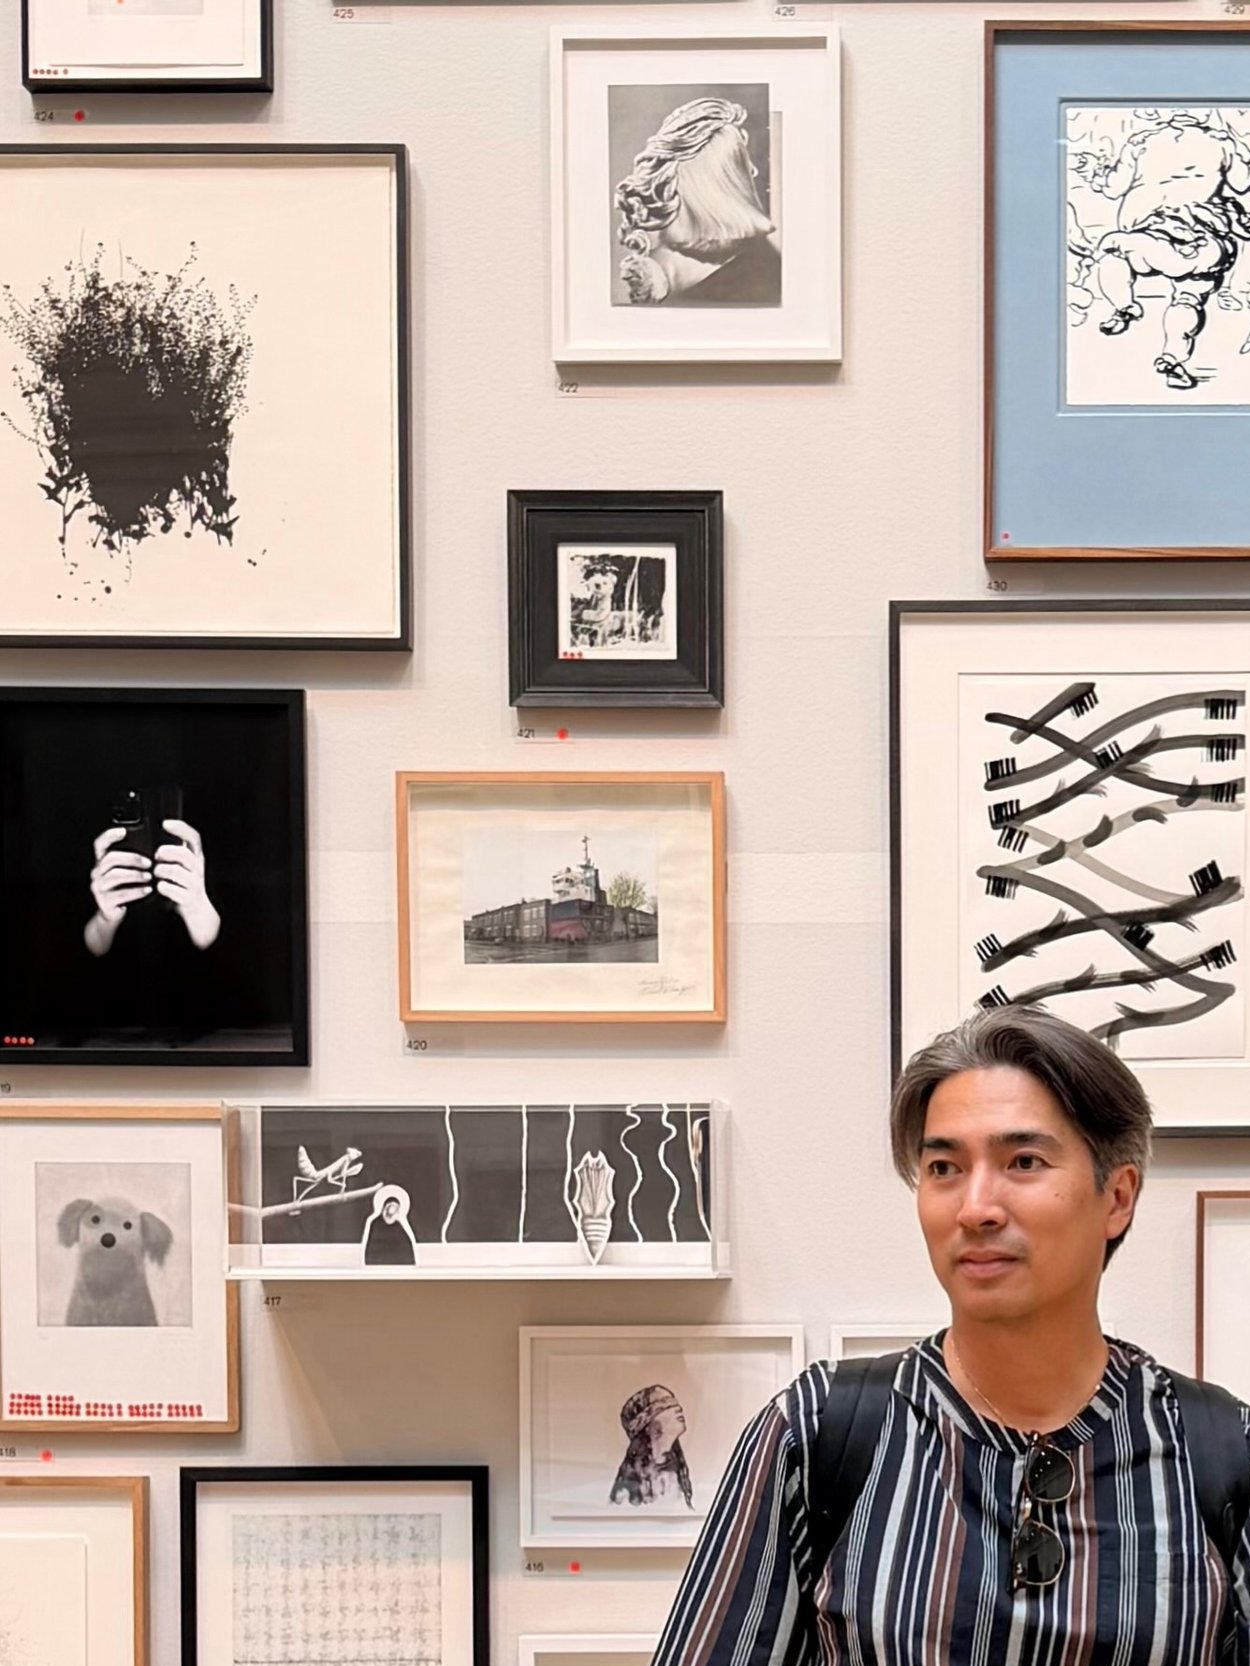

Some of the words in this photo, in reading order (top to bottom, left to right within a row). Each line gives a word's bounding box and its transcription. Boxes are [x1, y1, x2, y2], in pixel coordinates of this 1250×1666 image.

[333, 8, 354, 19] 425
[33, 111, 54, 121] 424
[986, 580, 1007, 592] 430
[406, 1040, 427, 1051] 420
[264, 1296, 281, 1306] 417
